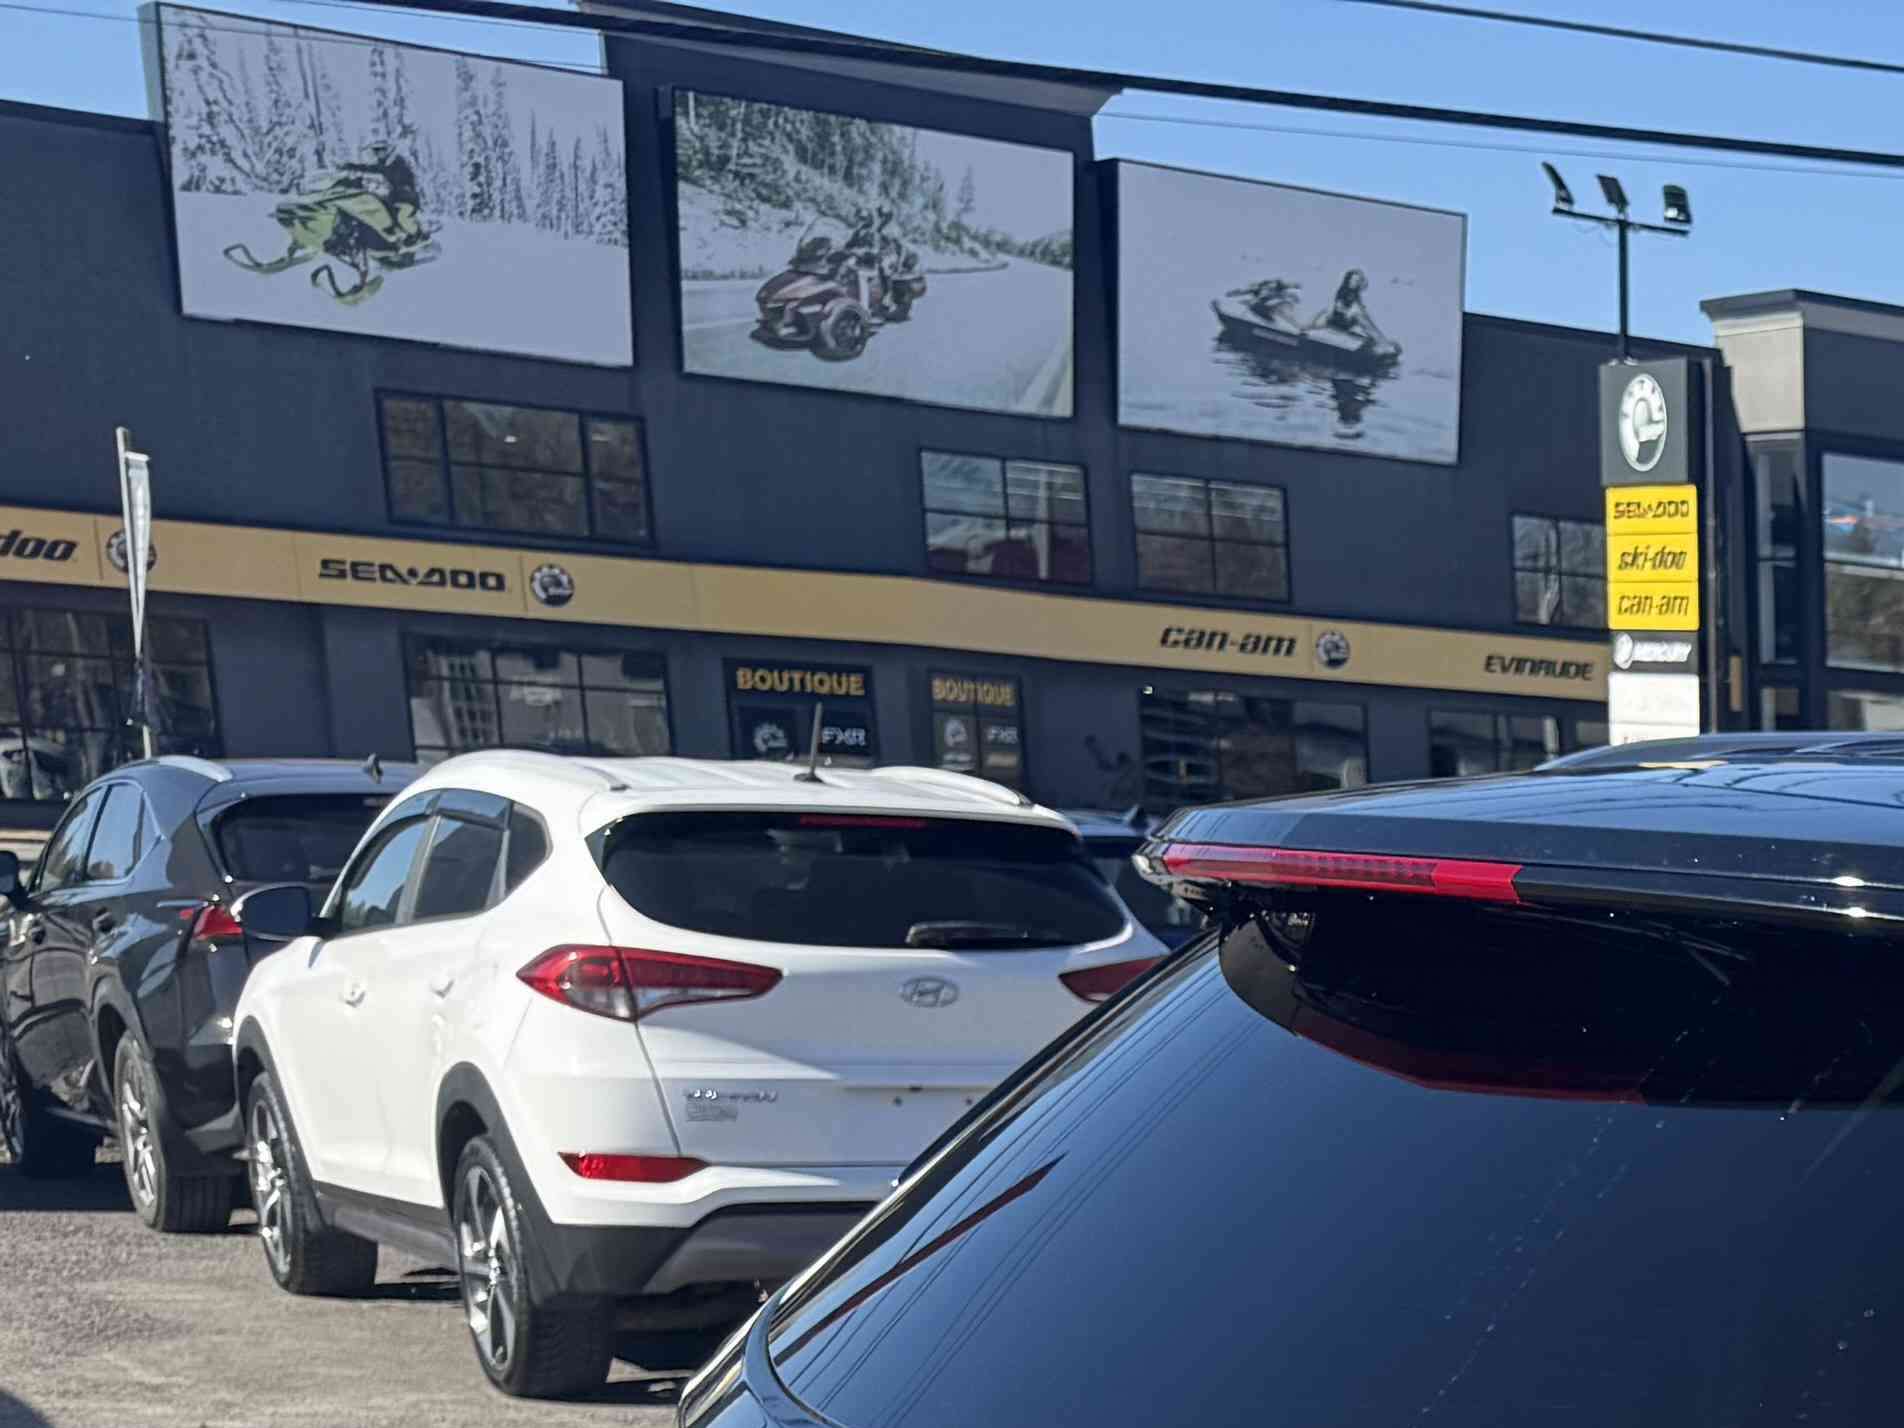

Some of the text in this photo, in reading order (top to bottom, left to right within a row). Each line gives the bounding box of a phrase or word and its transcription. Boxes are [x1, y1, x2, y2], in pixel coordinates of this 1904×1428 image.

[1617, 594, 1689, 617] can-am
[1160, 625, 1297, 657] can-am
[735, 667, 866, 697] BOUTIQUE
[1484, 655, 1594, 682] EVINRUDE
